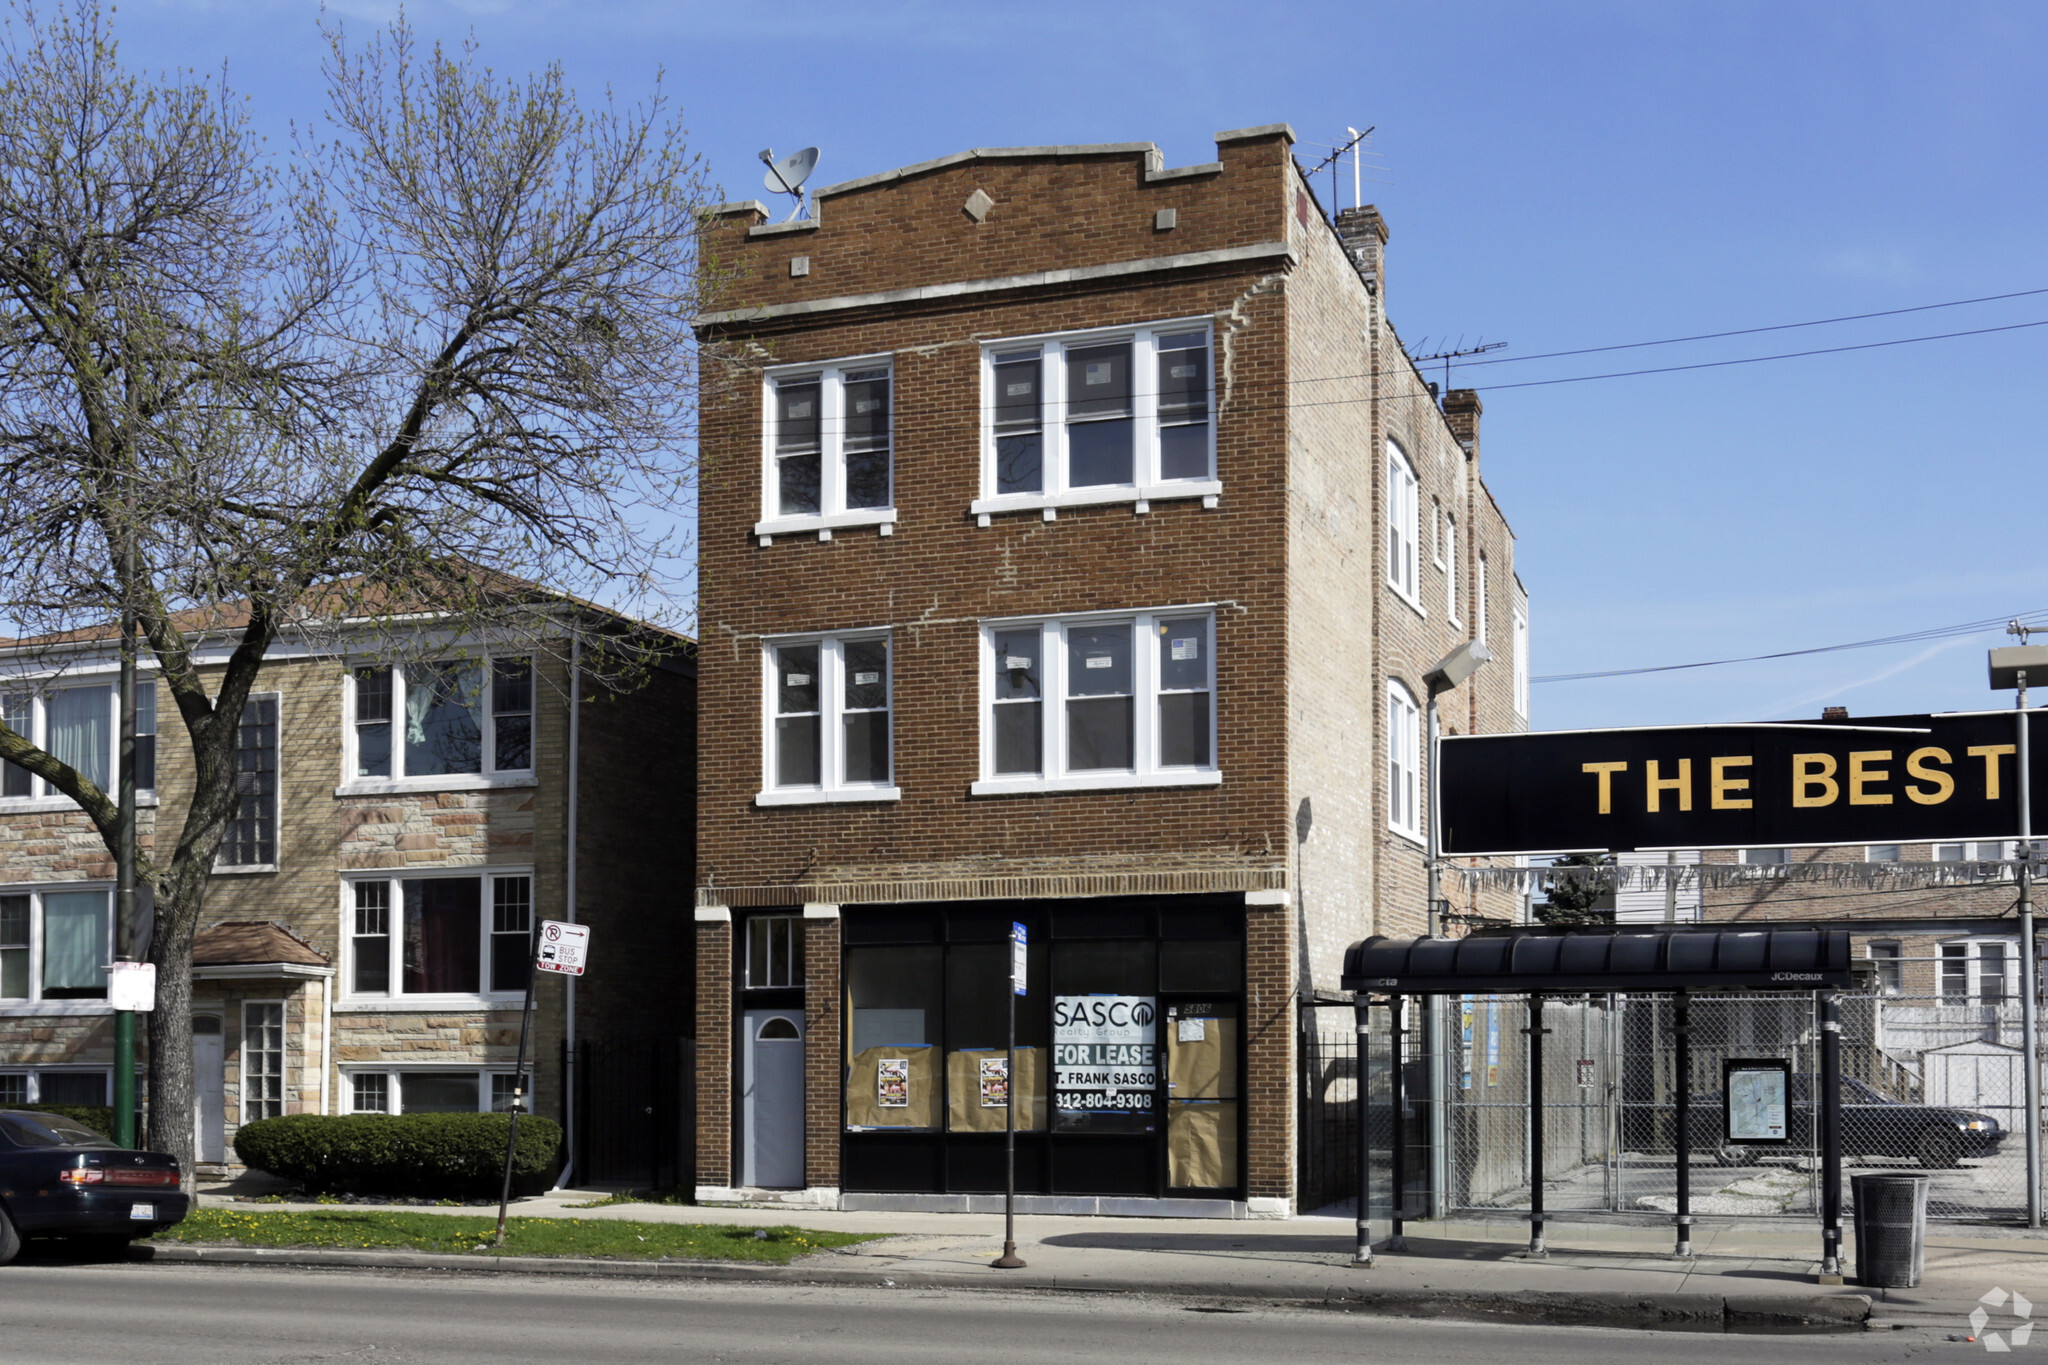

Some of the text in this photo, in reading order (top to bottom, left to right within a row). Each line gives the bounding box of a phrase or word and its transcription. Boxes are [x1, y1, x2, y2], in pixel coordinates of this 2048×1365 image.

[1582, 744, 2017, 814] THE BEST
[560, 947, 575, 956] BUS
[559, 956, 578, 964] STOP
[559, 965, 578, 973] ZONE
[1771, 971, 1823, 981] JCDecaux
[1054, 1002, 1154, 1027] SASCO
[1054, 1028, 1130, 1039] Realty Group
[1055, 1045, 1153, 1064] FOR LEASE
[1054, 1072, 1155, 1085] T. FRANK SASCO
[1056, 1093, 1152, 1108] 312-804-9308
